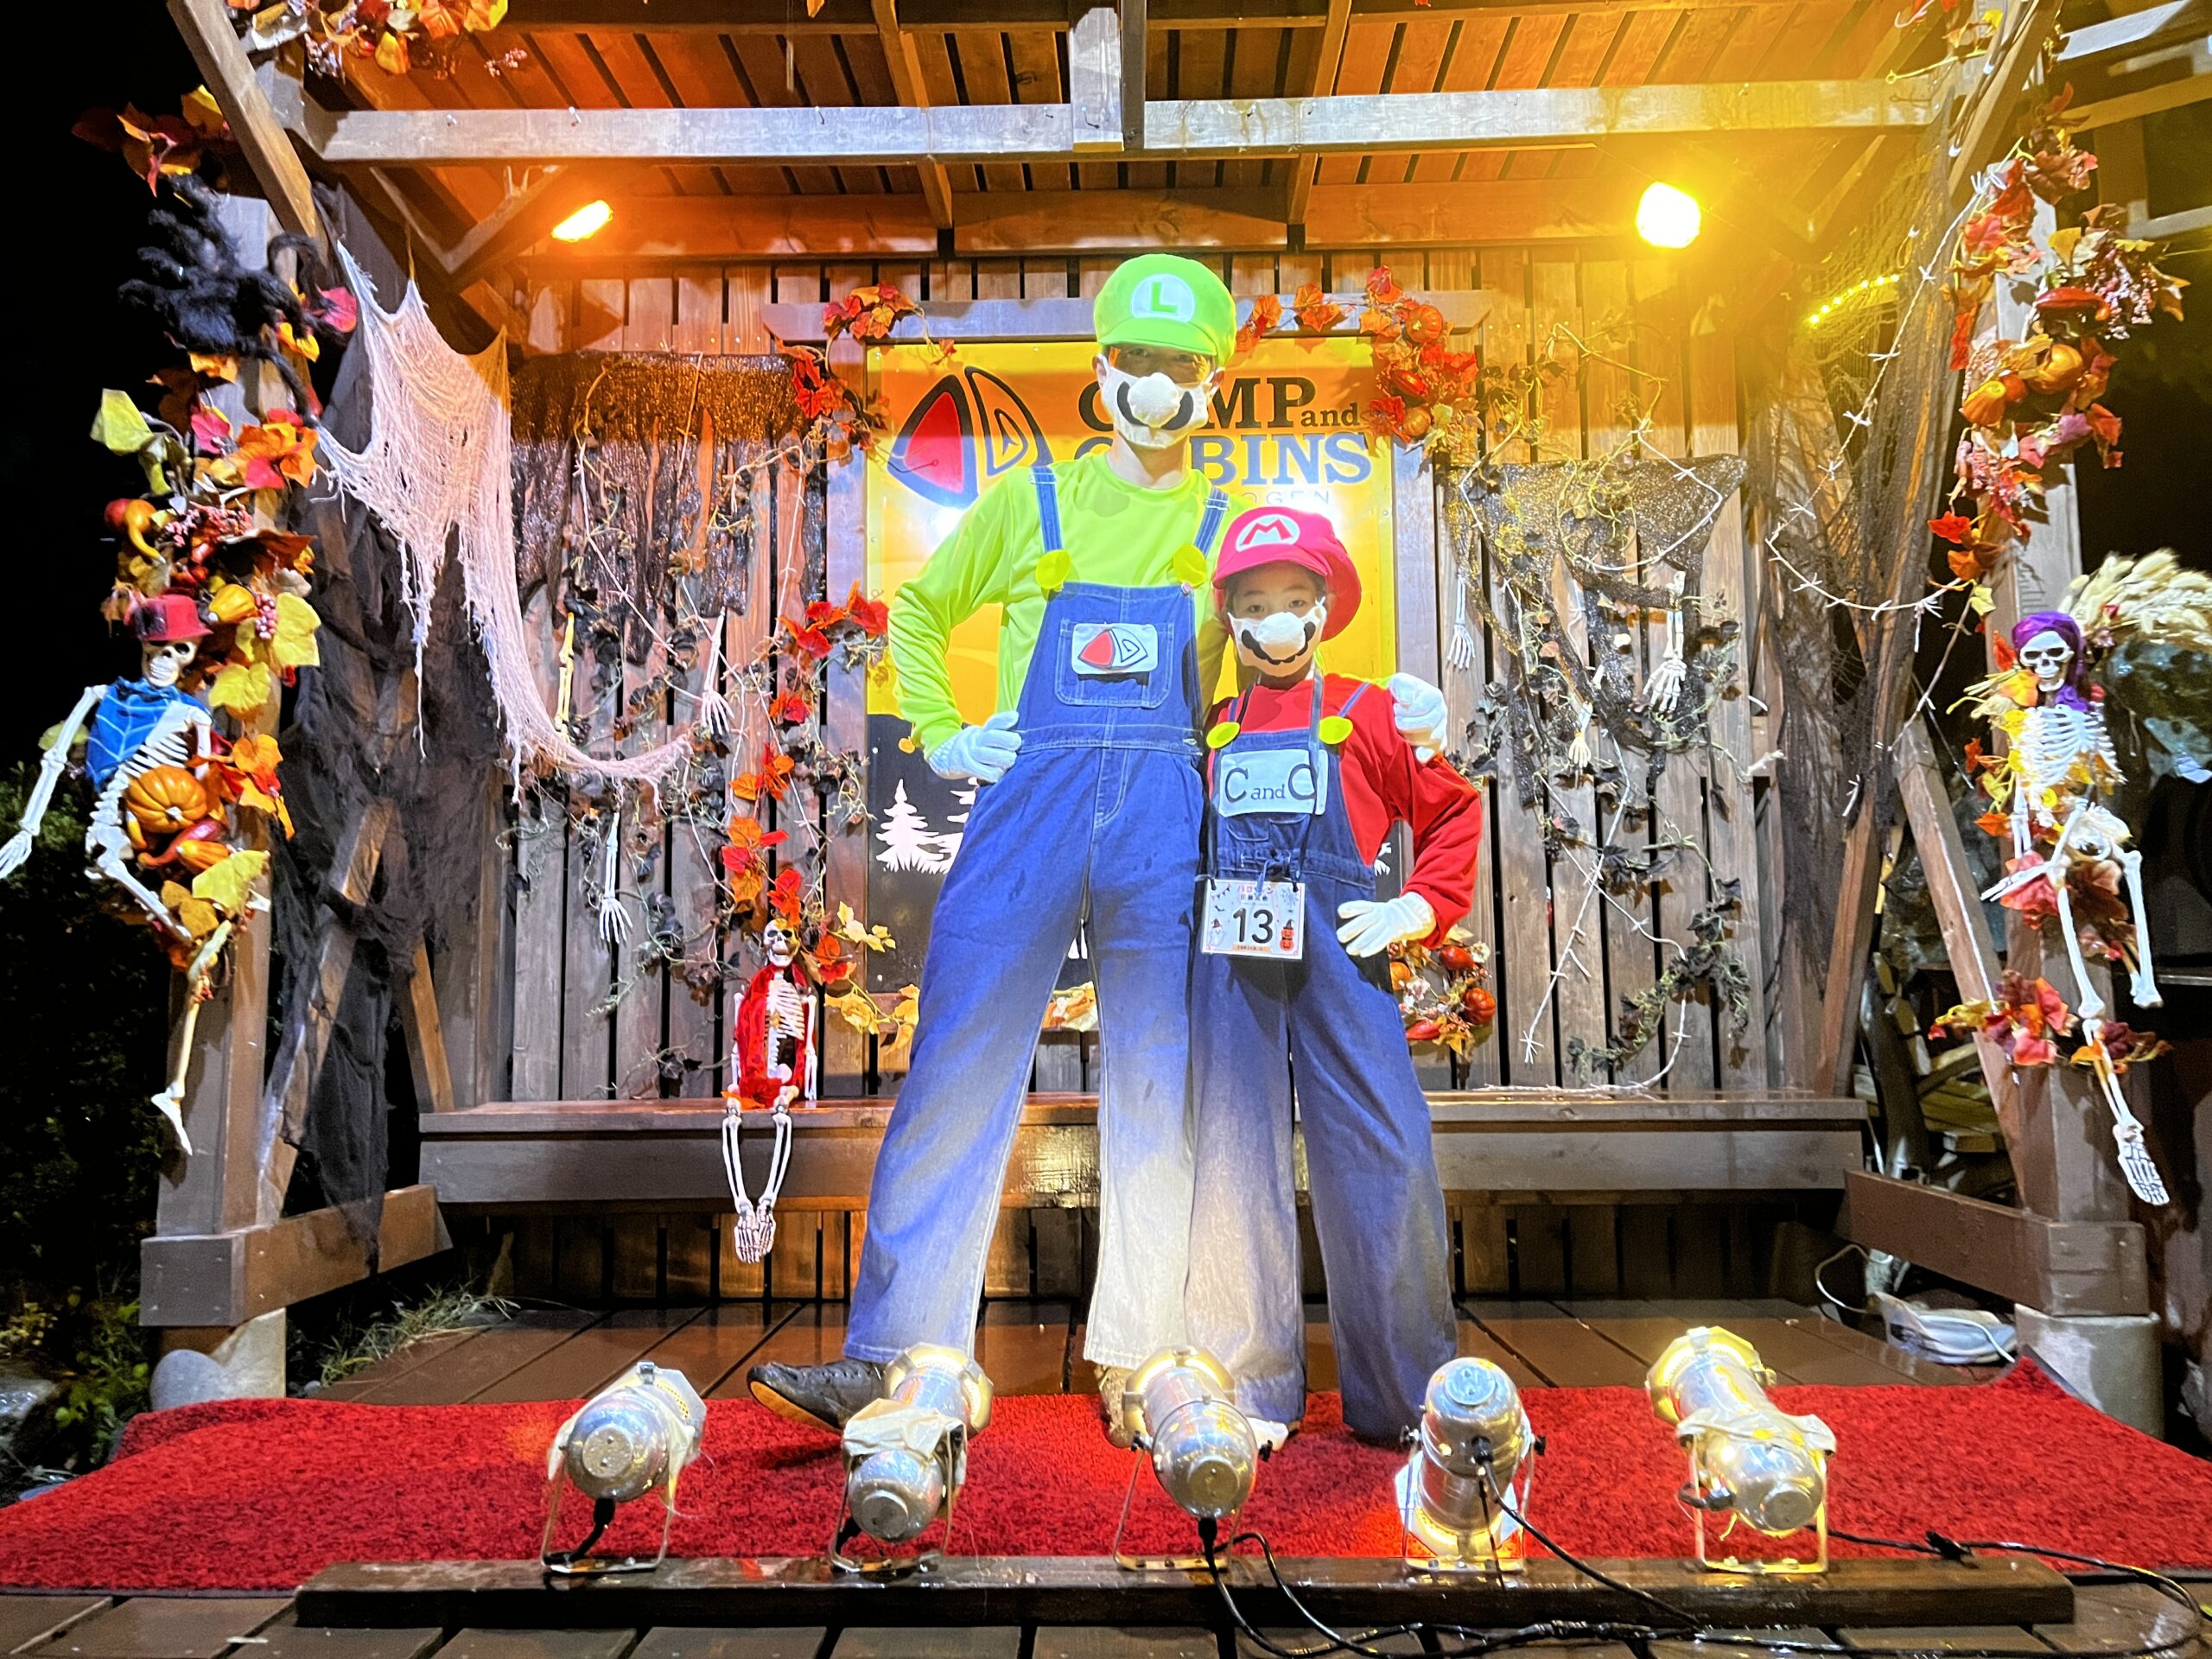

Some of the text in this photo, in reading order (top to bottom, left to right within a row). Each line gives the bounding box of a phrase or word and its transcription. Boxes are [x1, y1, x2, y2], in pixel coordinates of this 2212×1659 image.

[1149, 281, 1179, 315] L
[1078, 377, 1360, 431] CMP and
[1074, 432, 1372, 486] BINS
[1240, 518, 1294, 546] M
[1233, 908, 1274, 944] 13
